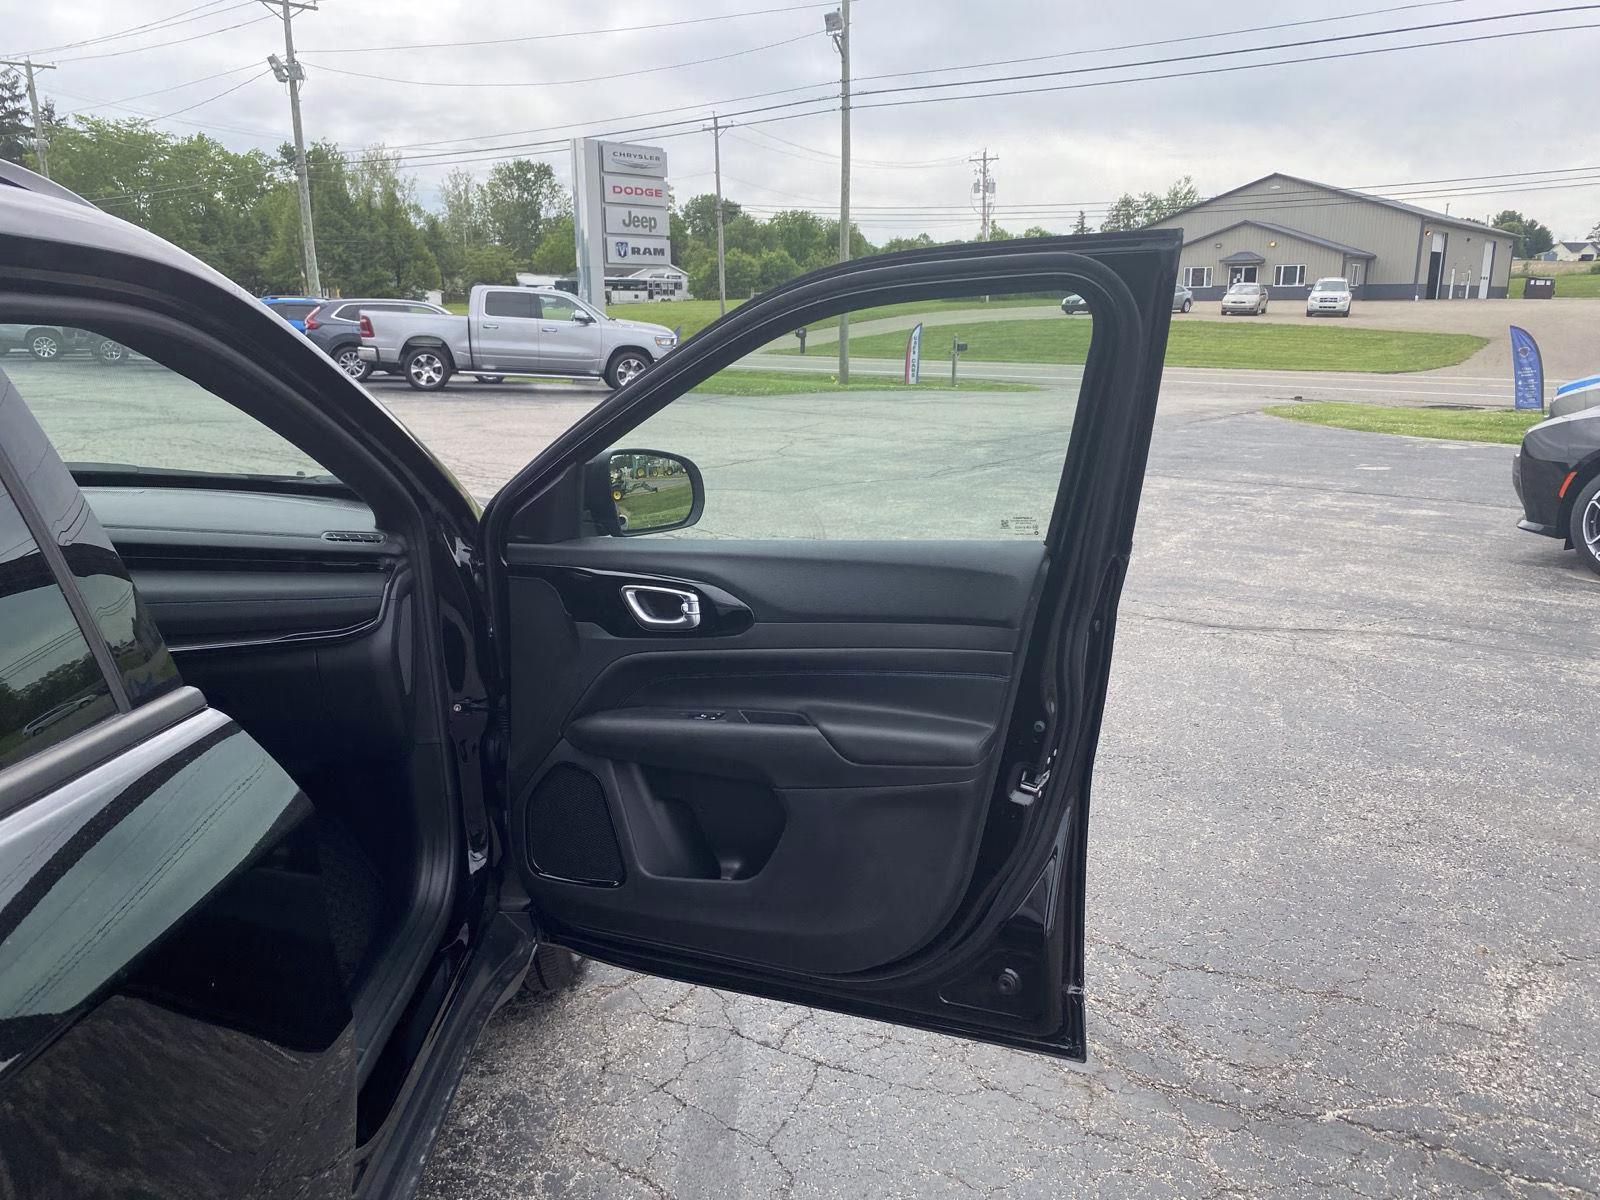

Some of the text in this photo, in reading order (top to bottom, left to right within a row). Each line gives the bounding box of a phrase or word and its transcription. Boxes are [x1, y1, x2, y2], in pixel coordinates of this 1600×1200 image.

[612, 151, 661, 162] CHRYSLER
[612, 185, 663, 197] DODGE
[622, 210, 658, 232] Jeep
[631, 246, 665, 257] RAM
